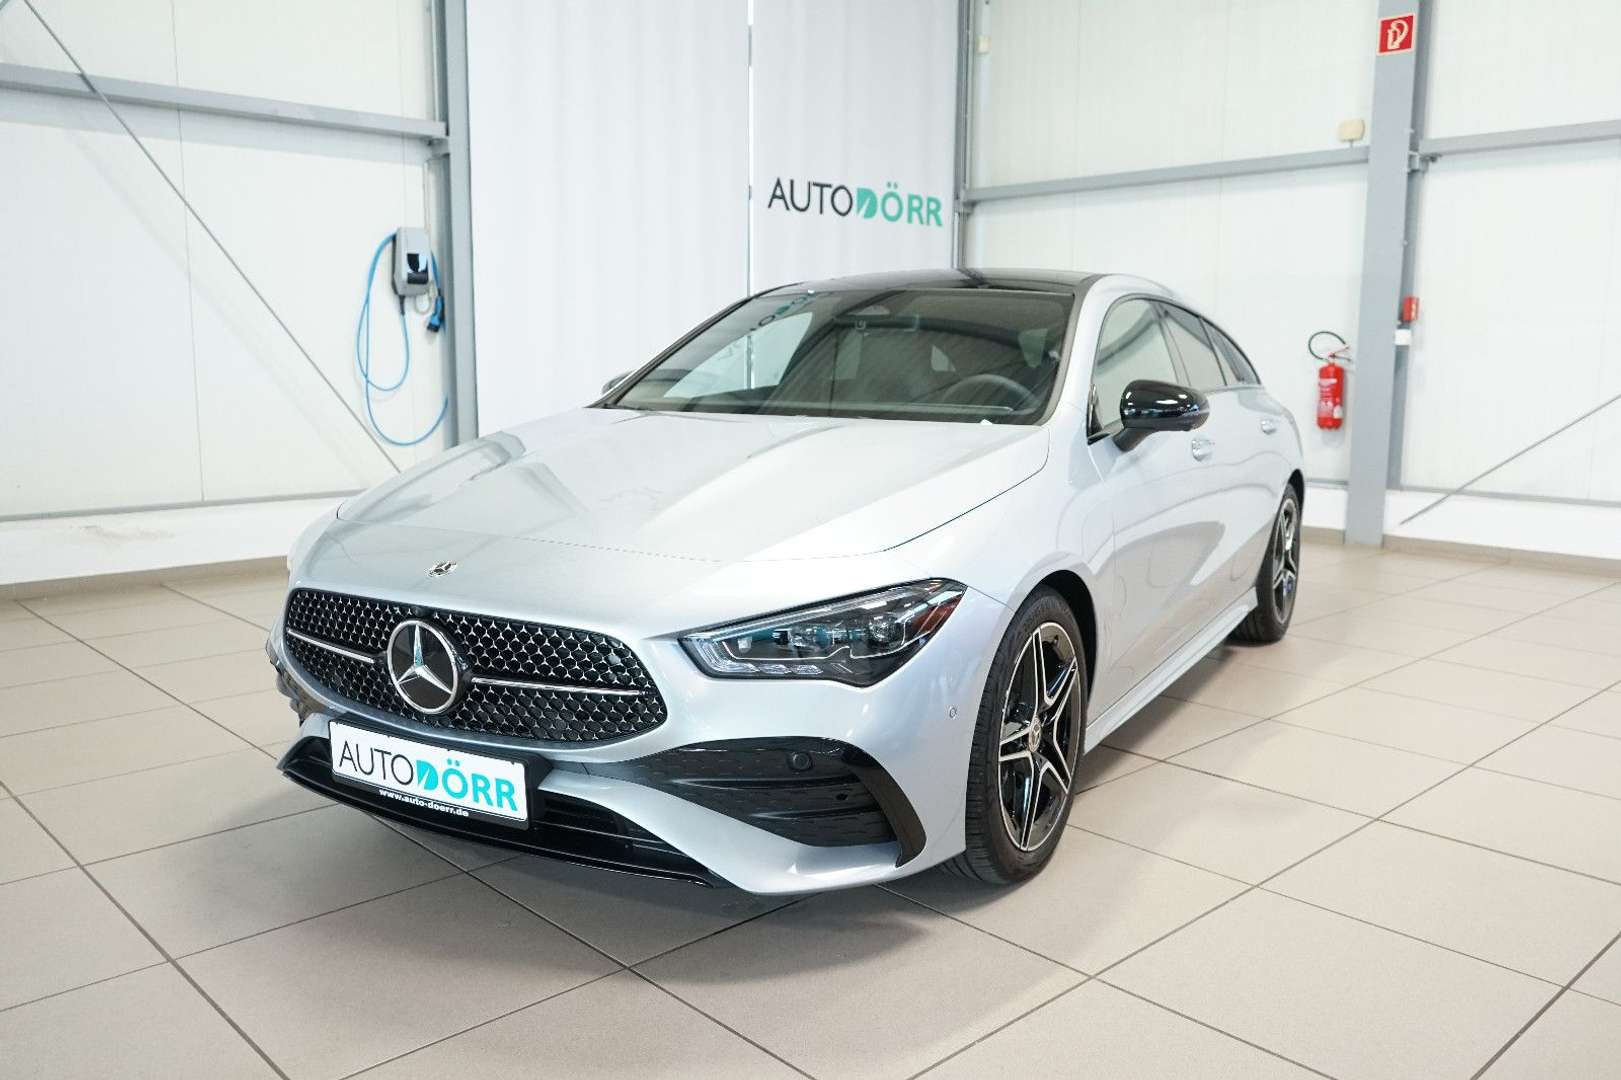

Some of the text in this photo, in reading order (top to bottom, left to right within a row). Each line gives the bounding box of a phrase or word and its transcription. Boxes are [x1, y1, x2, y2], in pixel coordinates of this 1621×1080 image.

[768, 177, 943, 227] AUTODÖRR
[339, 740, 518, 811] AUTODÖRR
[379, 788, 469, 817] www.auto-doerr.de
